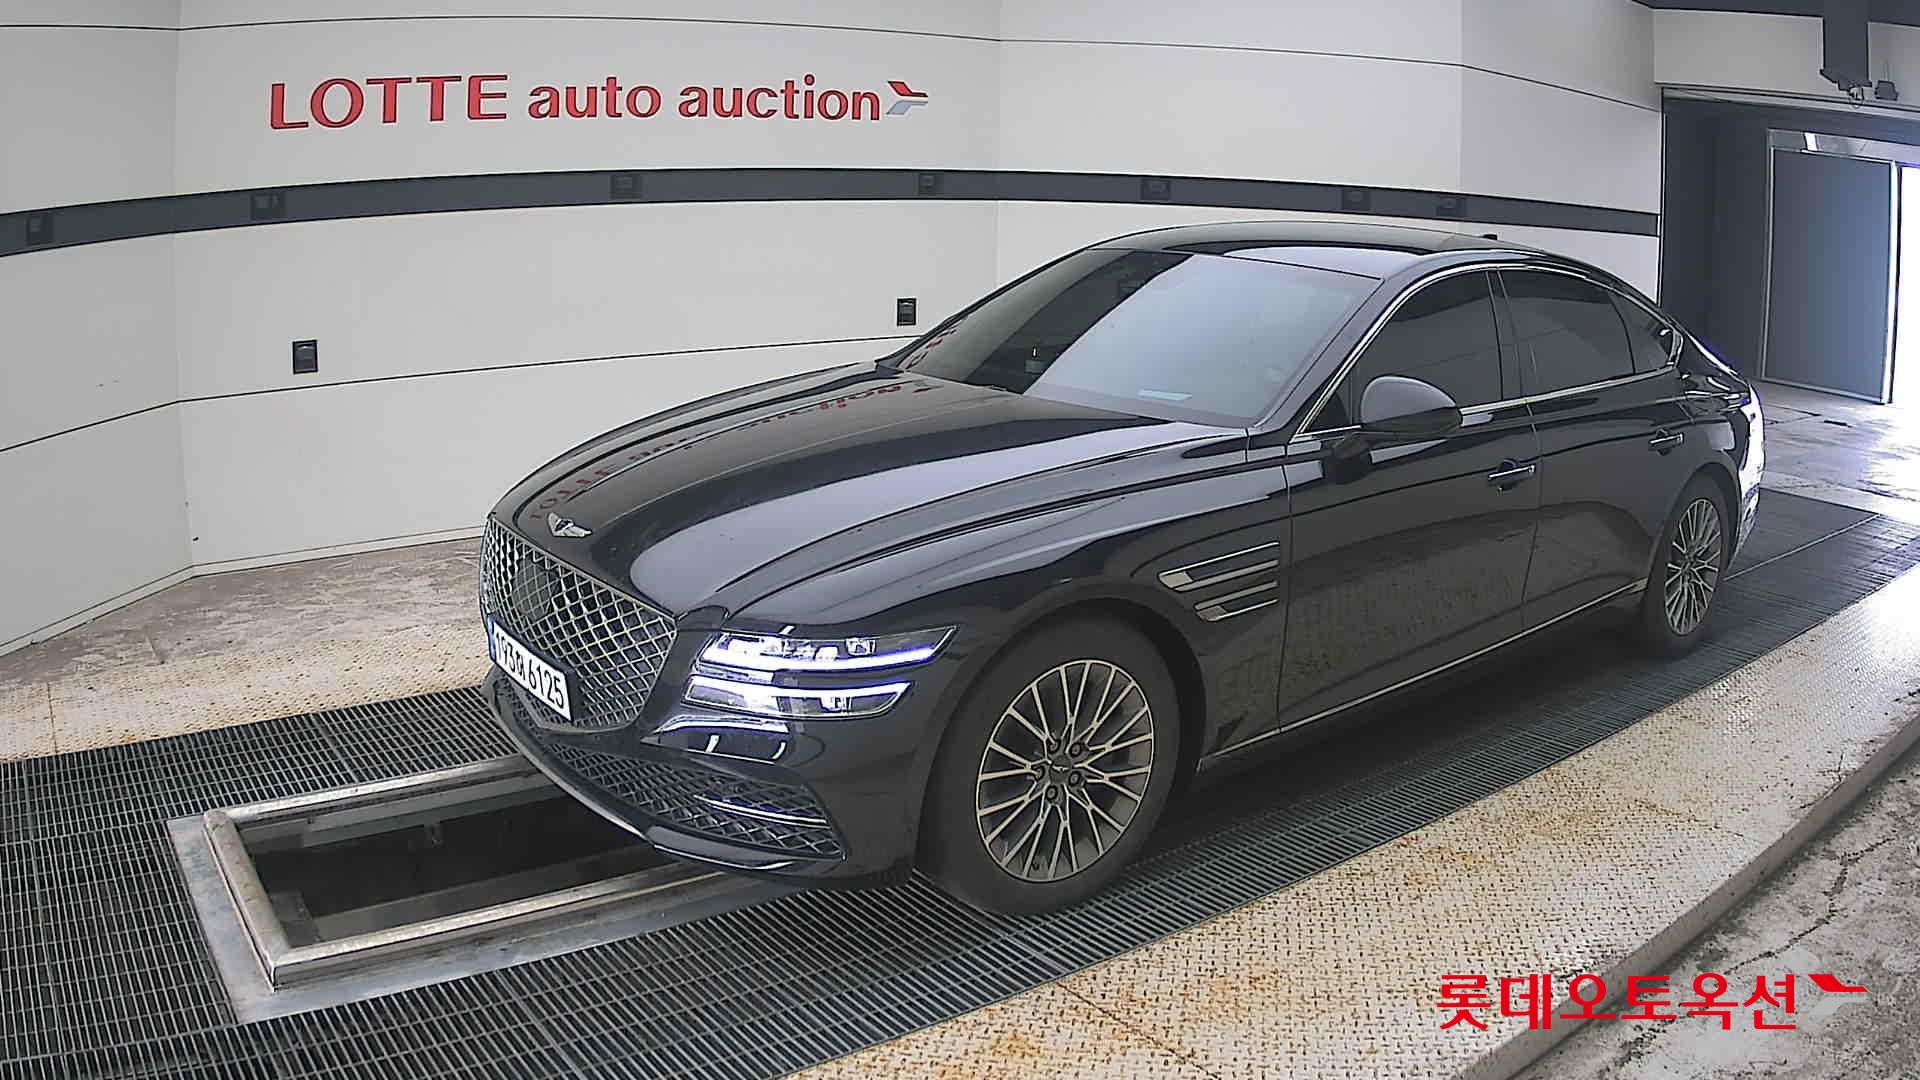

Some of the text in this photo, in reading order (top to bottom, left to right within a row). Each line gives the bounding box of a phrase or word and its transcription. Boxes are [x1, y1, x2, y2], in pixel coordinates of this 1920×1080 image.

[271, 74, 882, 129] LOTTE auto auction
